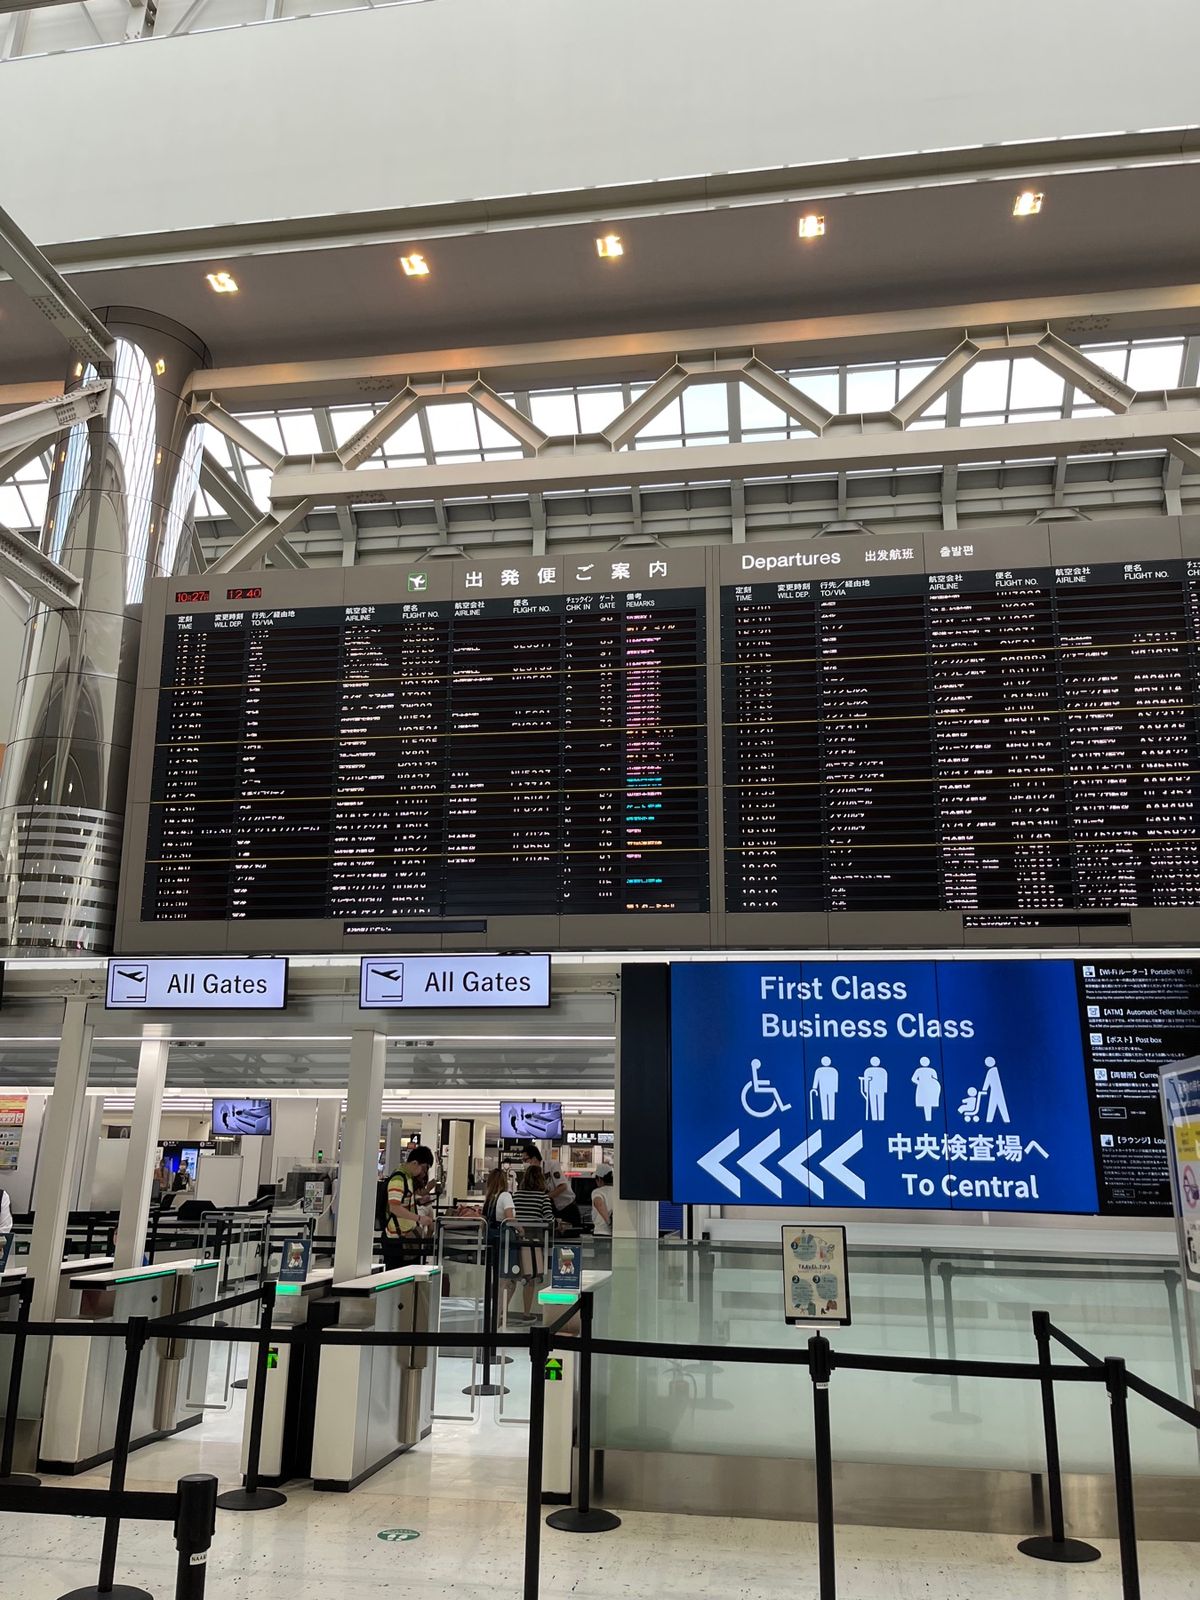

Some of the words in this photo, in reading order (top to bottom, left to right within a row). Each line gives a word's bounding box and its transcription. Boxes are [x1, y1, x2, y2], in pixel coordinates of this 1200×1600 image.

[864, 548, 914, 562] 出发航班
[939, 544, 974, 558] 출발편
[741, 550, 841, 571] Departures
[1055, 567, 1091, 576] 航空会社
[1123, 564, 1142, 572] 便名
[465, 561, 668, 588] 出発便ご案内
[929, 574, 963, 583] 航空会社
[995, 571, 1013, 579] 便名
[1124, 571, 1153, 580] FLIGHT
[1155, 570, 1170, 578] NO.
[995, 579, 1023, 587] FLIGHT
[1025, 578, 1039, 586] NO.
[1056, 575, 1087, 584] AIRLINE
[735, 586, 752, 594] 定刻
[777, 583, 811, 592] 変更時刻
[929, 582, 959, 590] AIRLINE
[566, 596, 593, 604] チェックイン
[599, 594, 615, 602] ゲート
[402, 604, 418, 612] 便名
[454, 601, 485, 609] 航空会社
[626, 599, 655, 608] REMARKS
[345, 606, 375, 615] 航空会社
[454, 609, 481, 617] AIRLINE
[513, 606, 537, 614] FLIGHT
[214, 613, 244, 621] 変更時刻
[345, 614, 371, 622] AIRLINE
[229, 620, 243, 628] DEP.
[1150, 968, 1176, 976] Portable
[166, 973, 195, 994] All
[203, 974, 268, 994] Gates
[424, 971, 454, 992] All
[462, 971, 531, 993] Gates
[760, 975, 823, 1000] First
[831, 975, 907, 1000] Class
[1126, 1008, 1157, 1016] Automatic
[1159, 1008, 1175, 1016] Teller
[761, 1013, 888, 1038] Business
[896, 1013, 975, 1038] Class
[412, 1135, 418, 1143] 4
[888, 1132, 1049, 1162] 中央検査場へ
[901, 1173, 933, 1196] To
[941, 1174, 1039, 1199] Central
